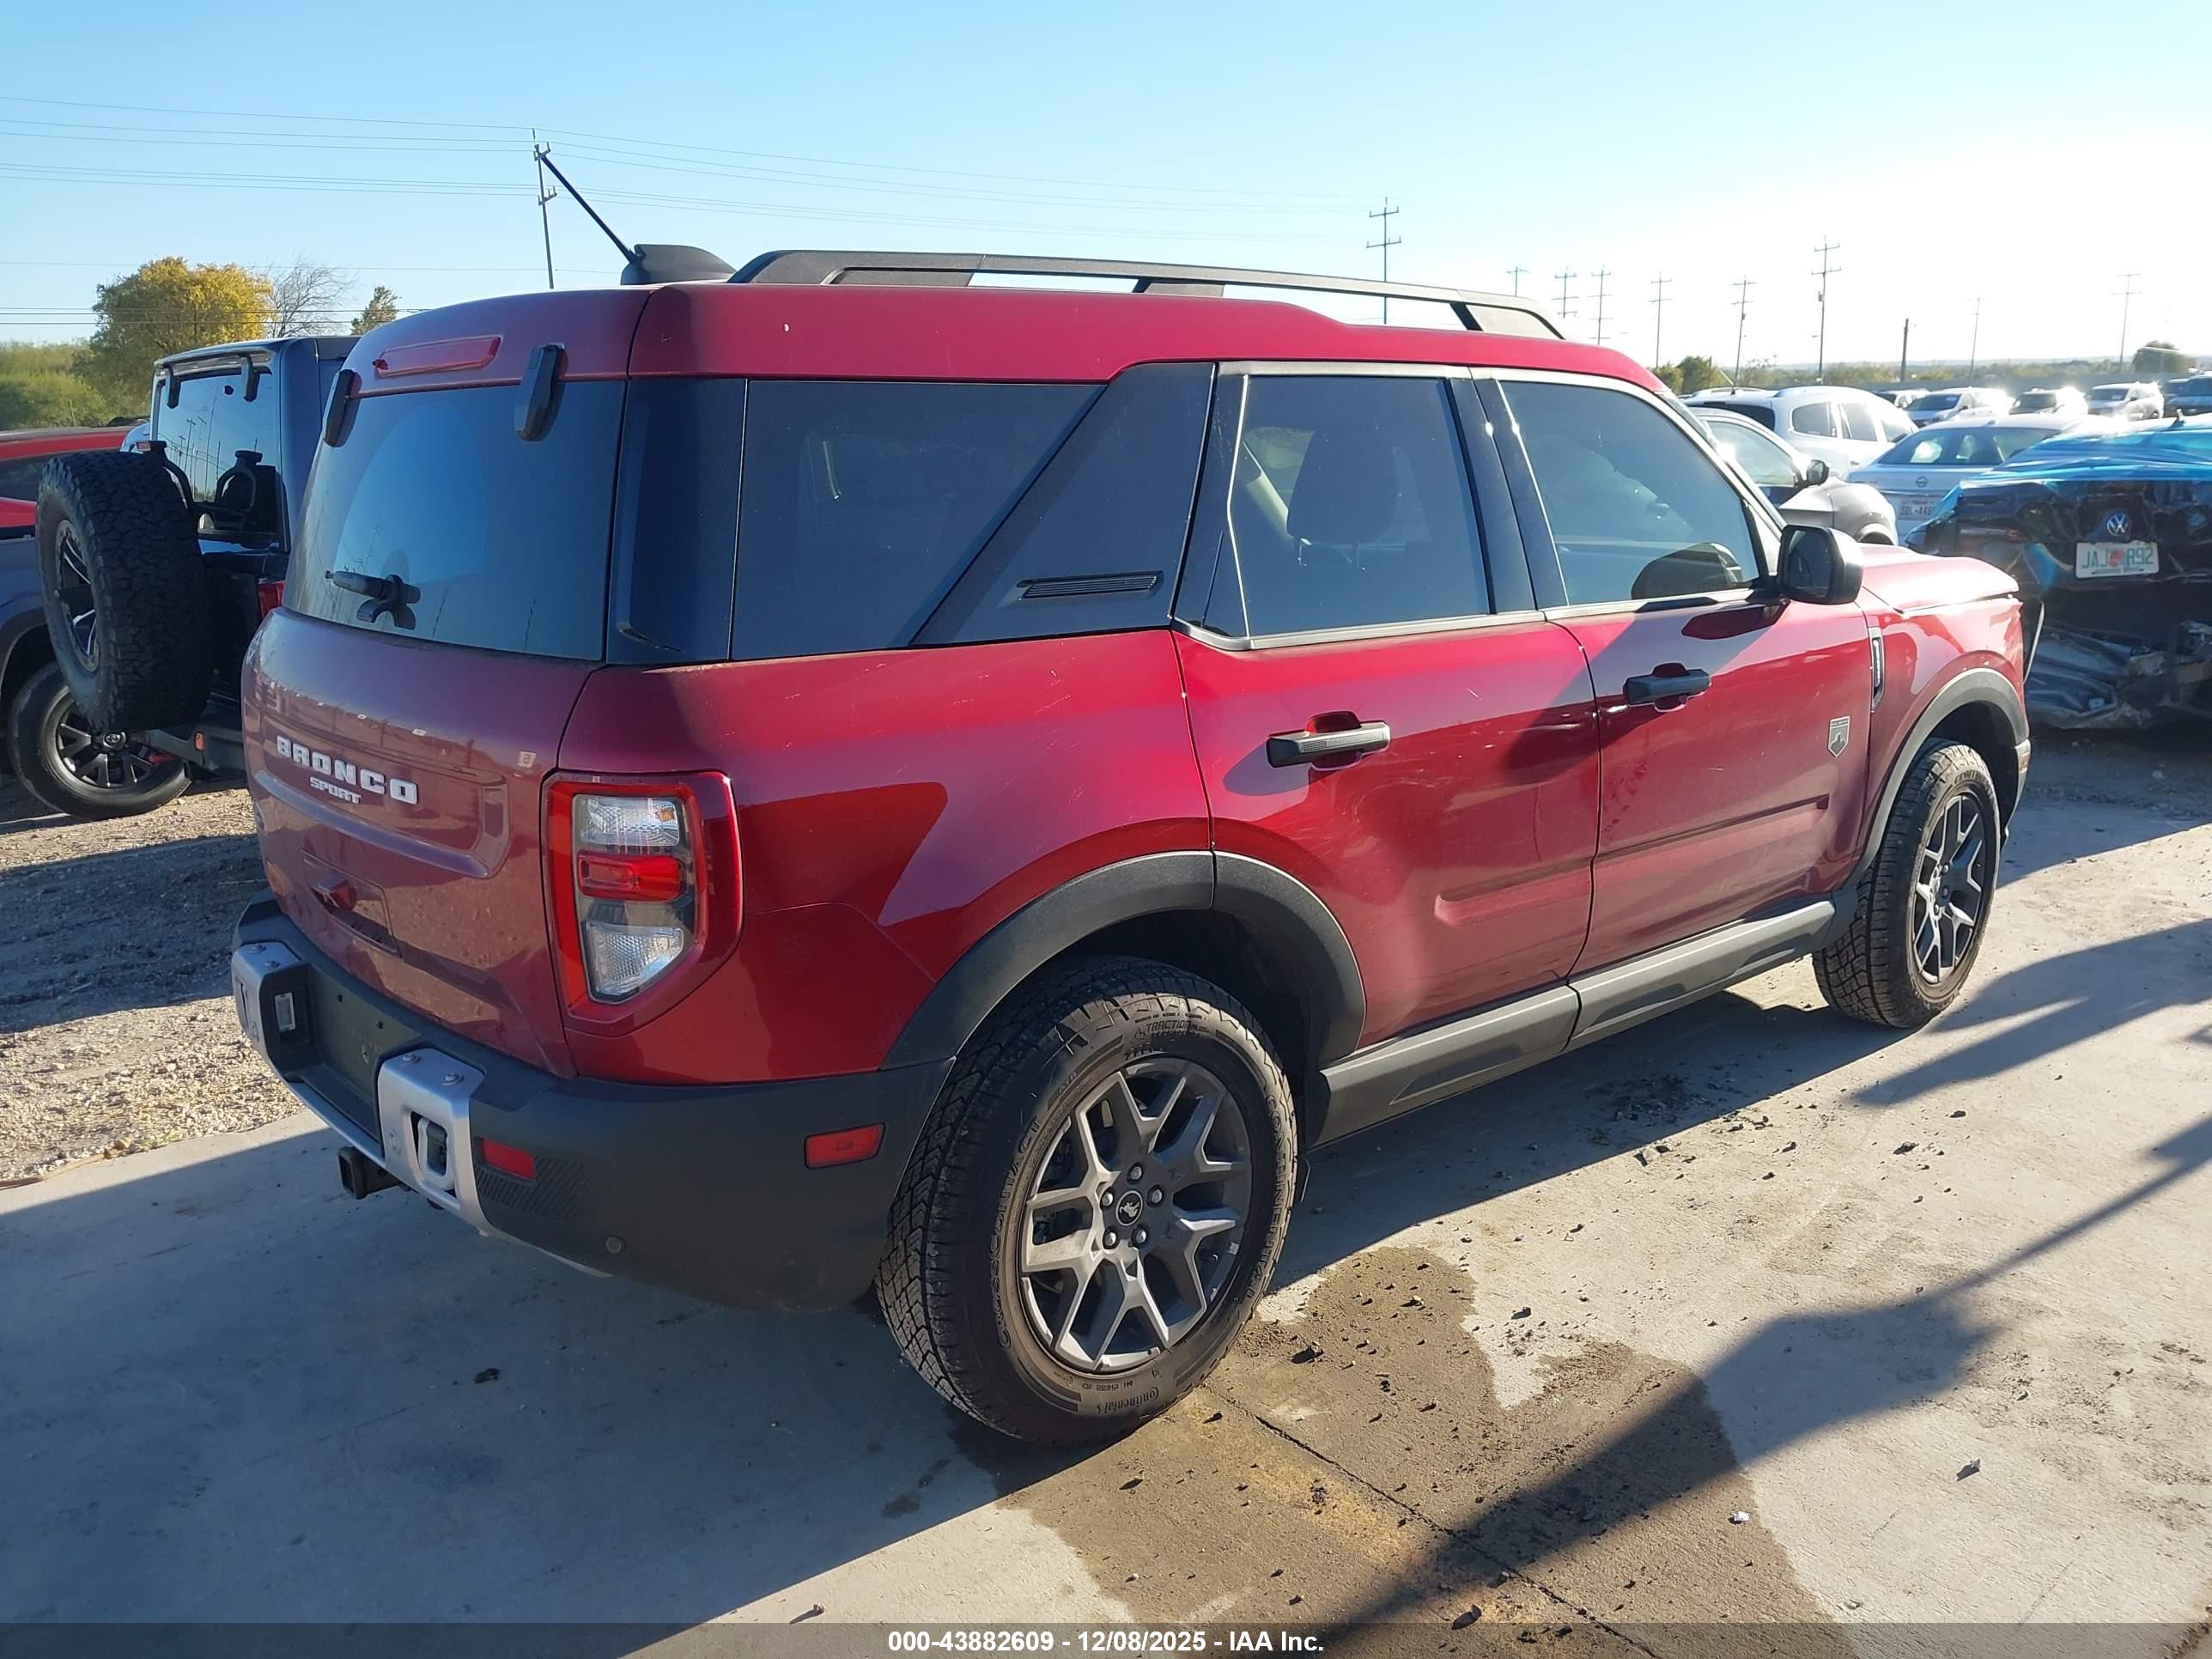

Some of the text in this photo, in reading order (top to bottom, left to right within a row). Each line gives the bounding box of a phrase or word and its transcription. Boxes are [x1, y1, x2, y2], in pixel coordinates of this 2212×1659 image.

[2126, 546, 2154, 565] R92
[276, 735, 419, 805] BRONCO
[310, 777, 362, 804] SPORT
[1146, 1019, 1191, 1031] TRACTION
